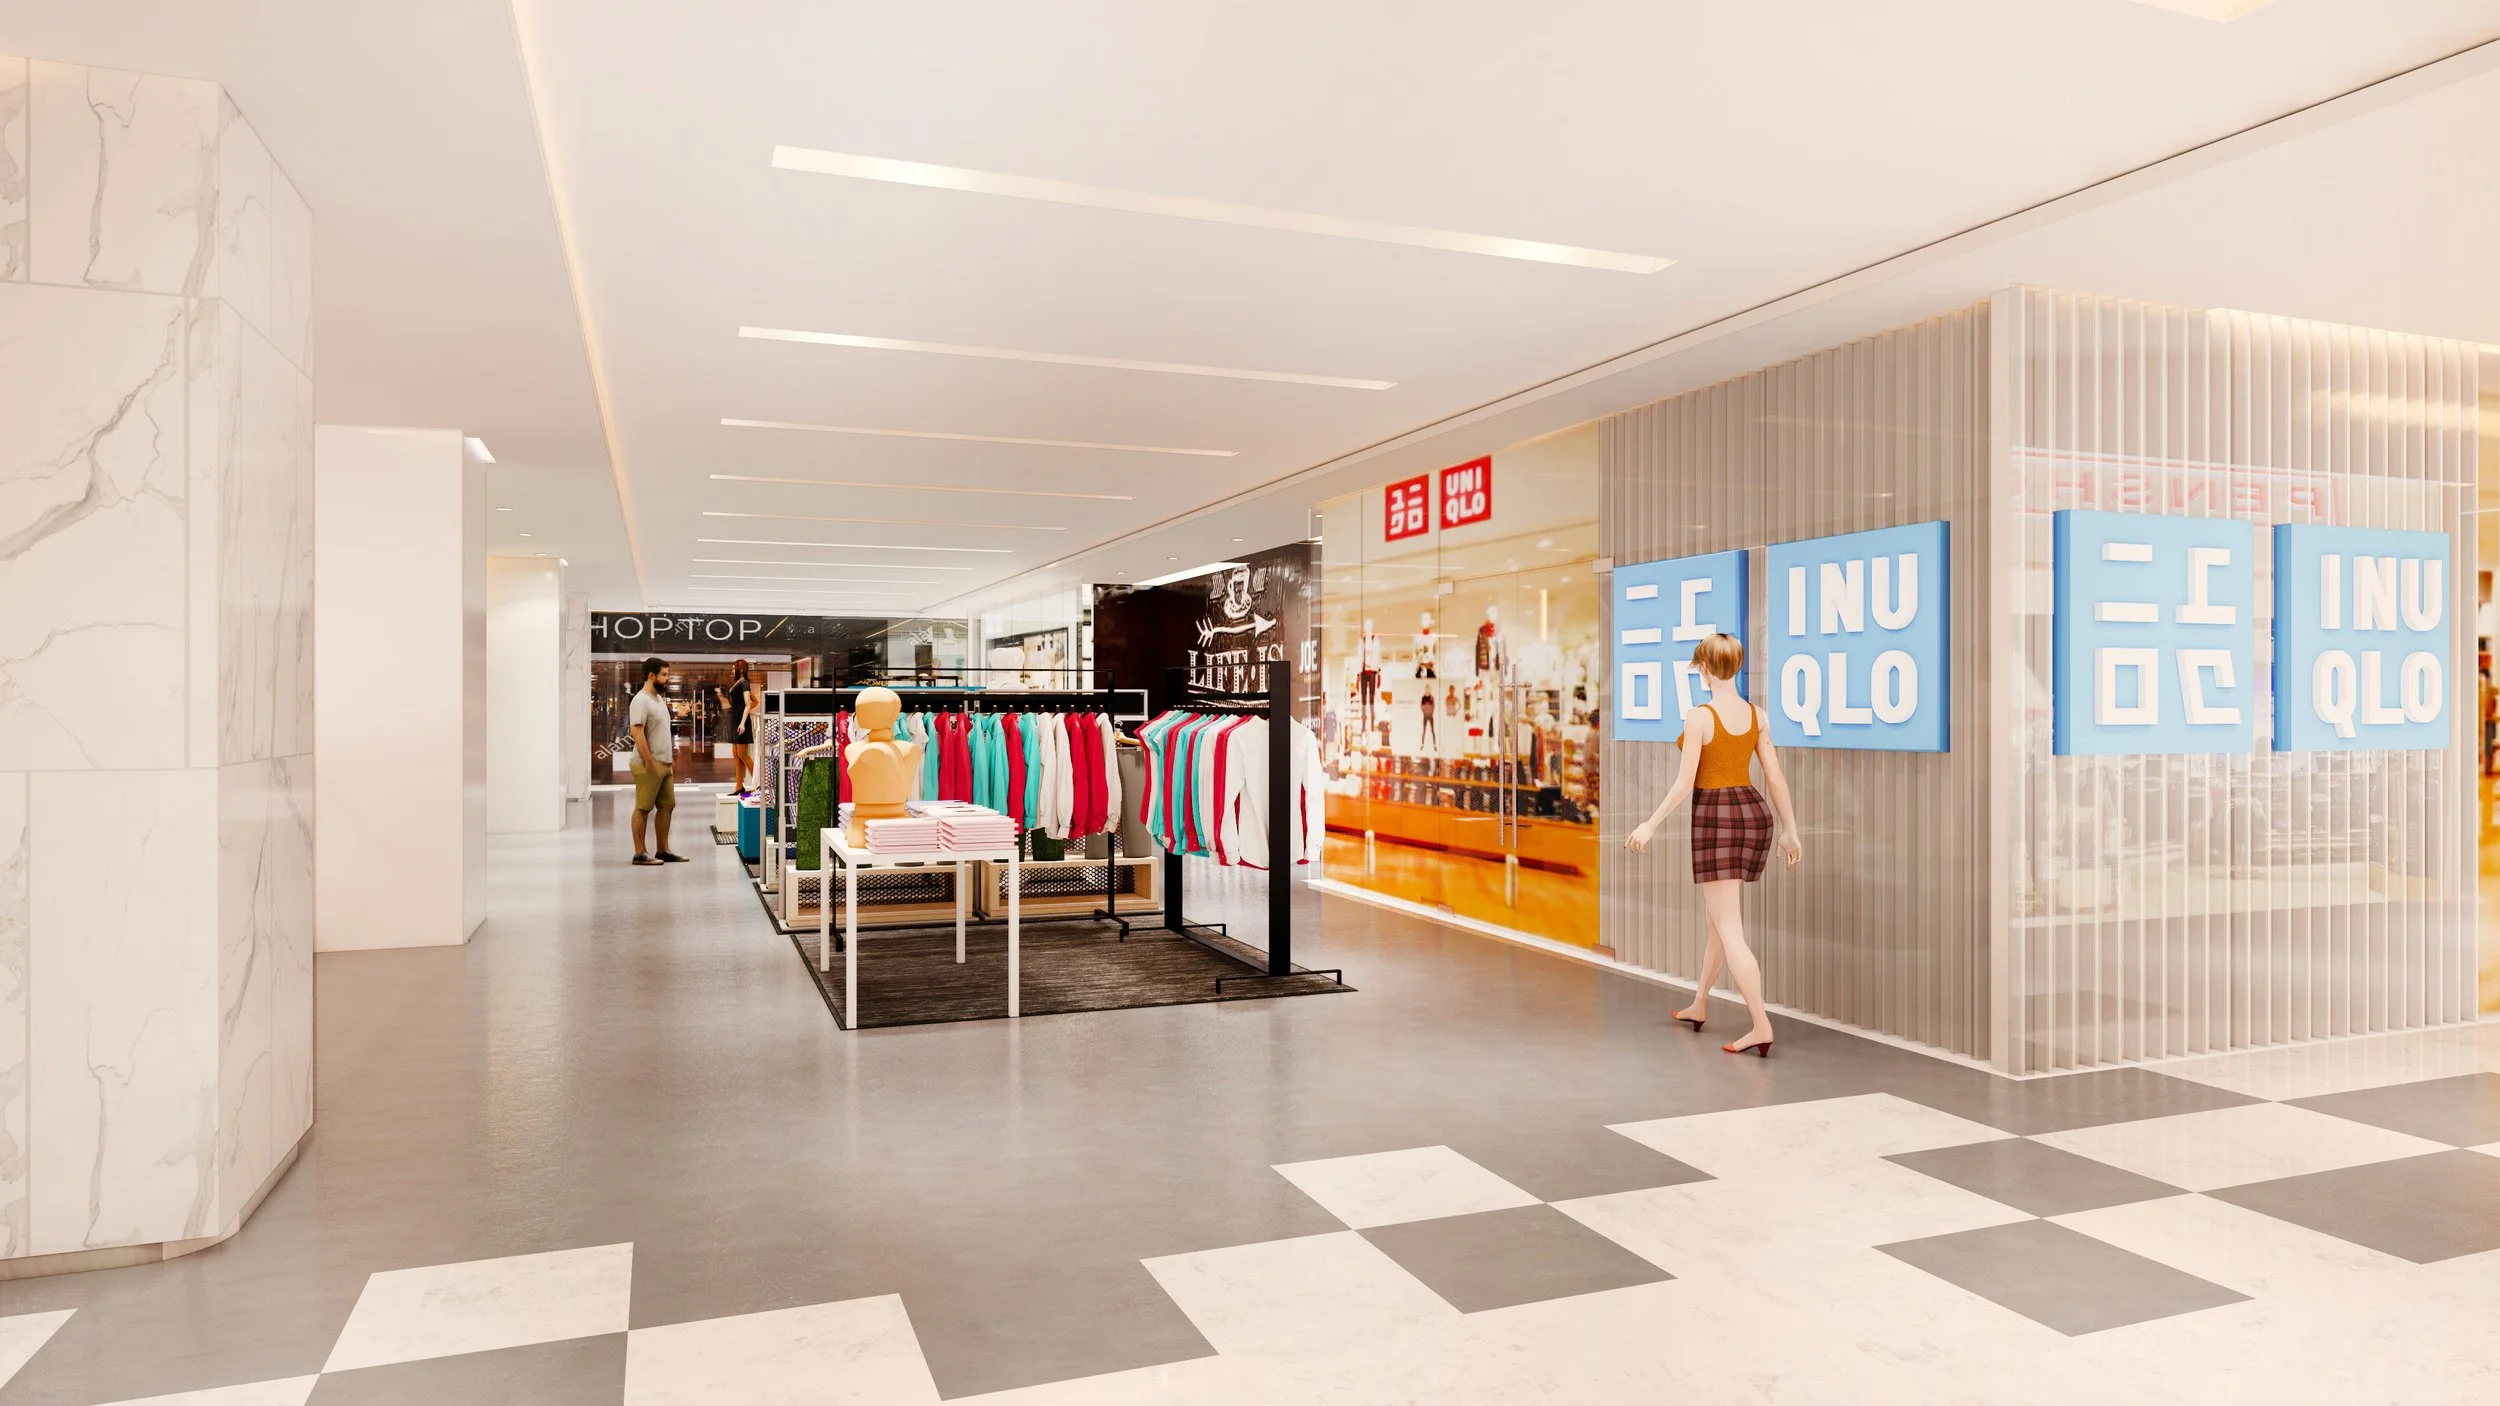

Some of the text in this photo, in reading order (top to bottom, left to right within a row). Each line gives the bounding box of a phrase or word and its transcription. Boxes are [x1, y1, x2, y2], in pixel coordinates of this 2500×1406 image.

[1446, 466, 1482, 496] UNI
[1446, 491, 1486, 523] QLO
[1788, 553, 1919, 637] INU
[2320, 554, 2443, 632] INU
[1187, 650, 1249, 694] LIFE
[1299, 640, 1318, 674] JOE
[1781, 650, 1919, 737] QLO
[2312, 650, 2443, 739] QLO
